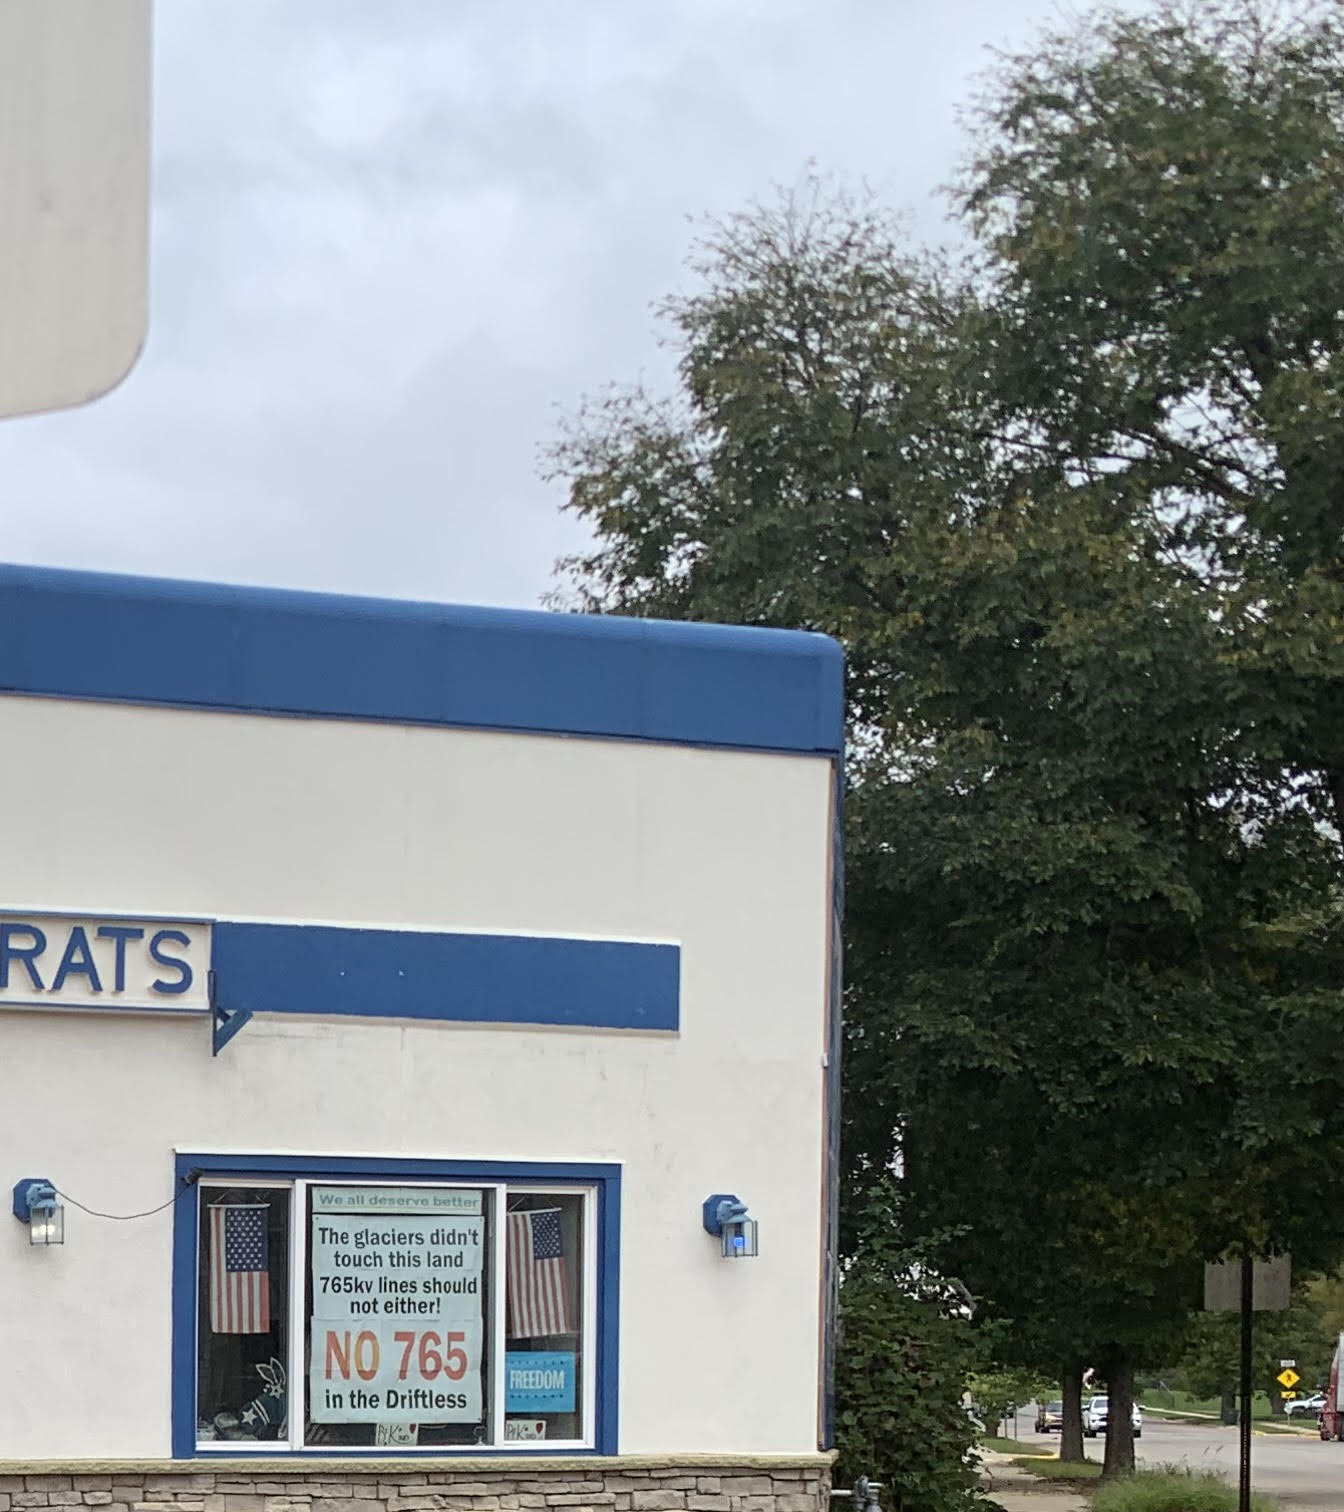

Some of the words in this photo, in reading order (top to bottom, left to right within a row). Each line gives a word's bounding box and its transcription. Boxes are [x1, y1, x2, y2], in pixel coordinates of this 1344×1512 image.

[320, 1195, 343, 1204] We
[348, 1195, 364, 1205] all
[369, 1195, 429, 1206] deserve
[433, 1196, 478, 1207] better
[319, 1228, 349, 1244] The
[355, 1228, 425, 1249] glaciers
[430, 1228, 479, 1245] didn't
[334, 1251, 383, 1267] touch
[389, 1251, 421, 1267] this
[427, 1251, 463, 1267] land
[320, 1277, 373, 1293] 765kv
[379, 1277, 417, 1293] lines
[423, 1277, 477, 1294] should
[351, 1298, 378, 1314] not
[384, 1297, 440, 1314] either!
[325, 1330, 380, 1381] NO
[394, 1330, 468, 1381] 765
[510, 1369, 565, 1390] FREEDOM
[325, 1389, 343, 1409] in
[350, 1389, 379, 1409] the
[386, 1389, 467, 1409] Driftless
